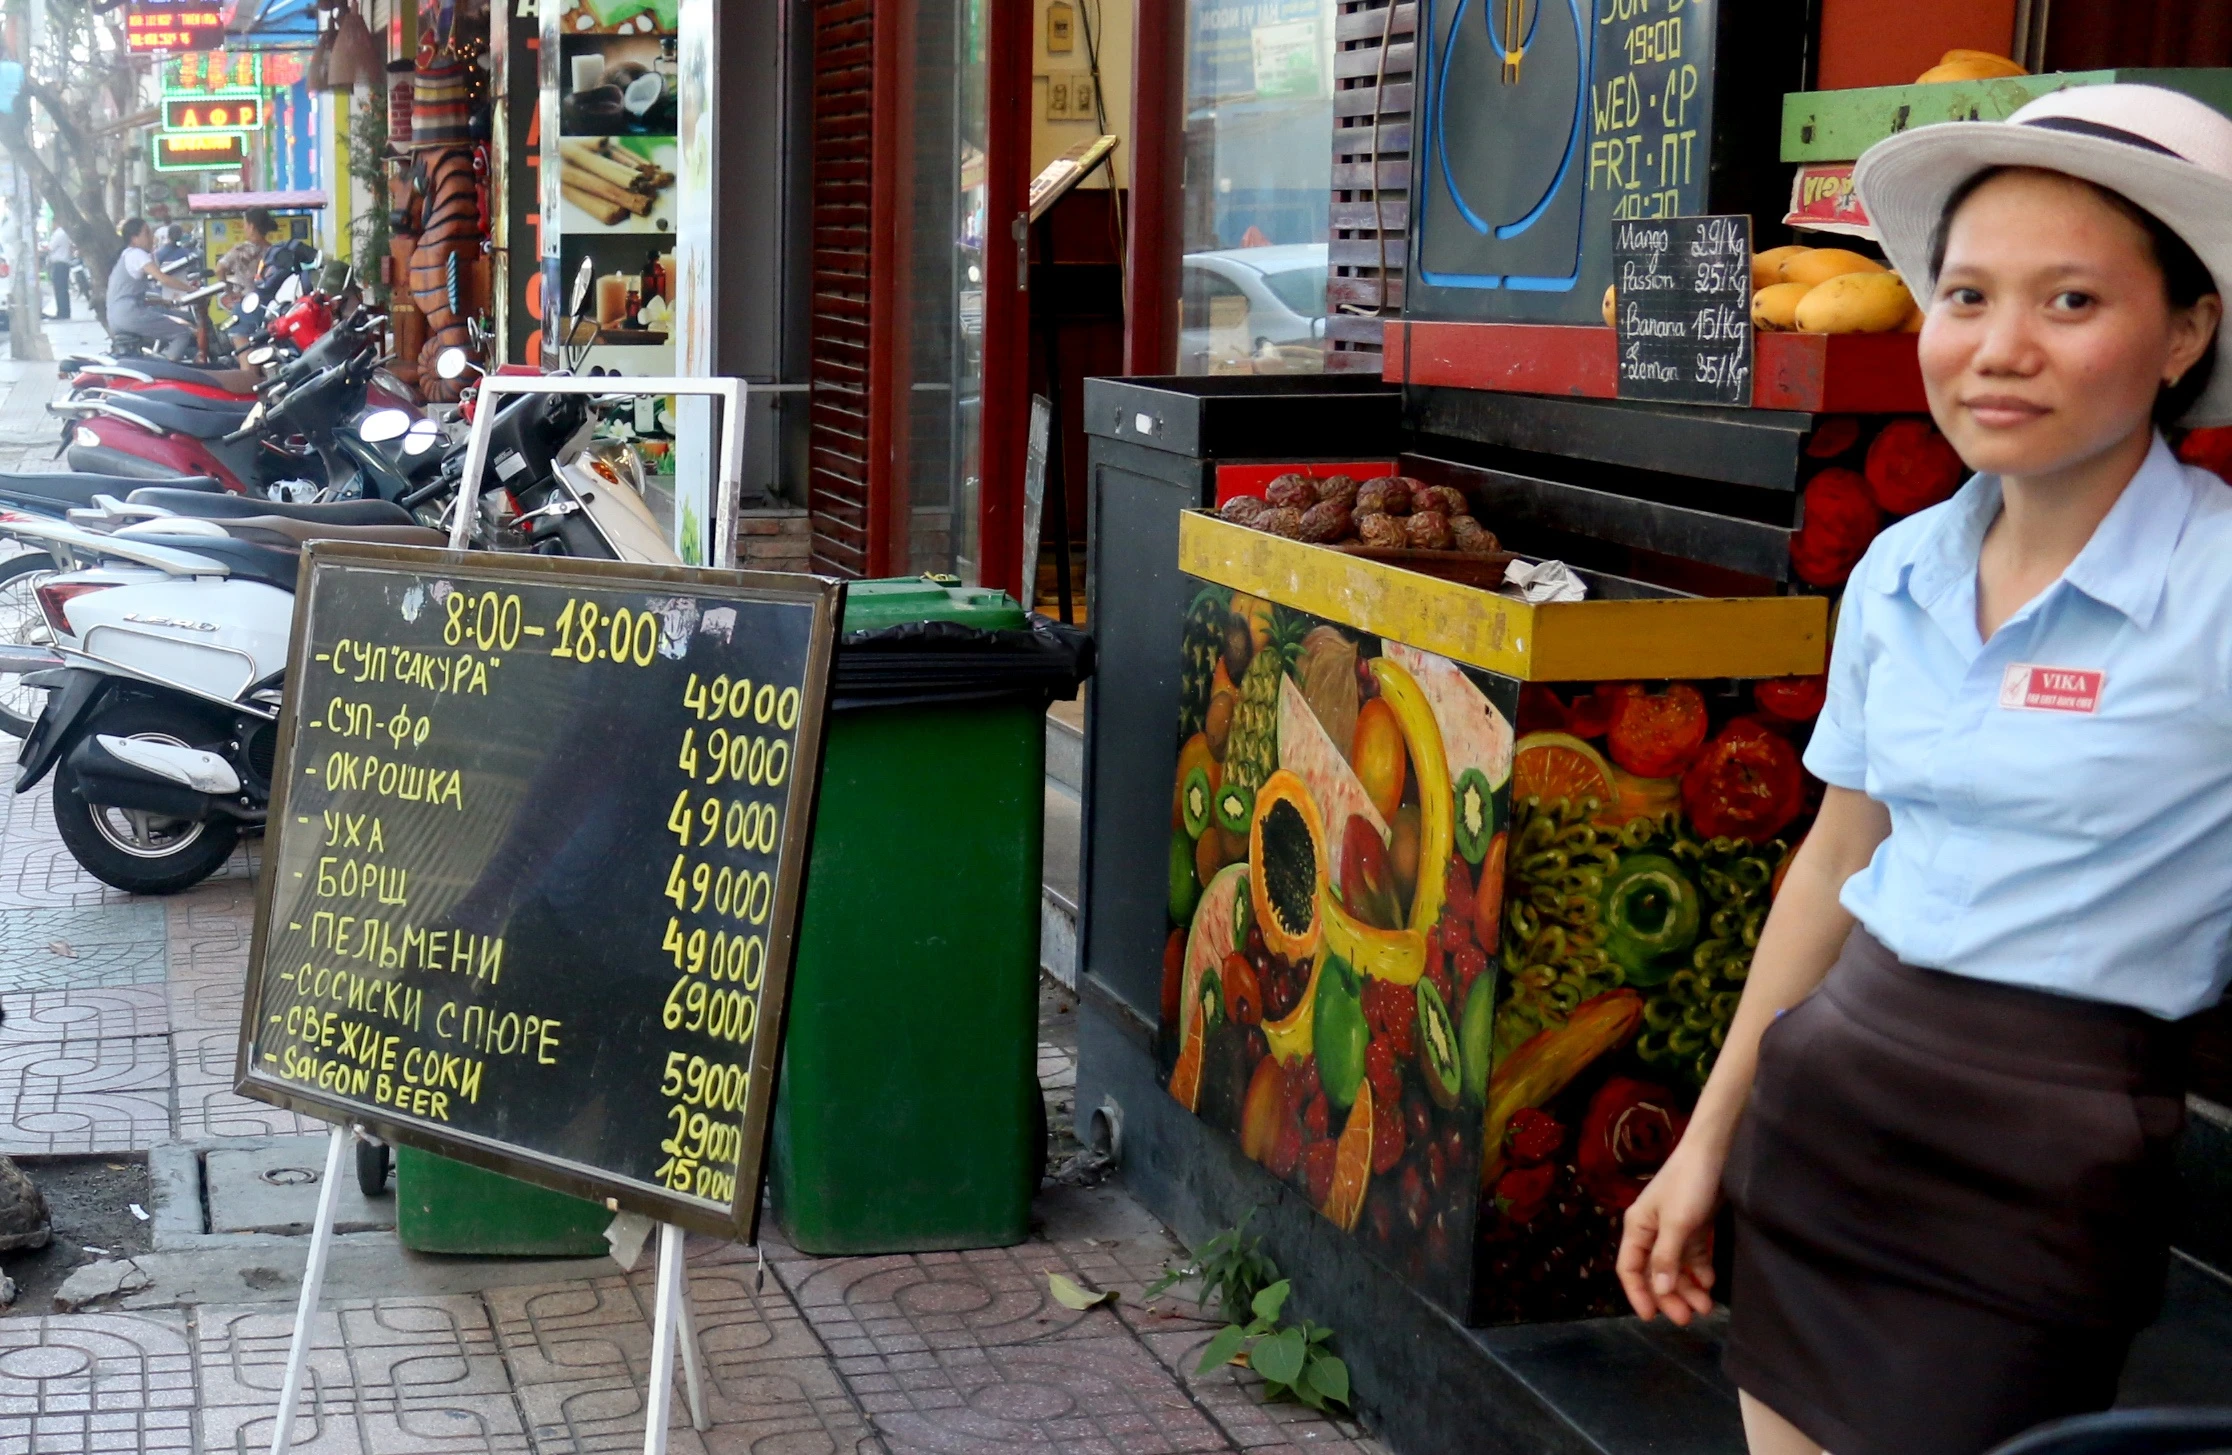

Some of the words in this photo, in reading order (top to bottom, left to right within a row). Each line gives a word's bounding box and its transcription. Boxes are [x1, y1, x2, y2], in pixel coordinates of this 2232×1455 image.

[1624, 16, 1681, 65] 19:00
[1593, 71, 1640, 135] WED
[1590, 135, 1642, 191] FRI
[1616, 223, 1669, 275] Mango
[1691, 218, 1745, 274] 29/Kg
[1623, 261, 1676, 294] Passion
[1695, 261, 1747, 309] 25/Kg
[1627, 302, 1686, 339] Banana
[1691, 304, 1746, 359] 15/Kg
[1626, 341, 1680, 383] Lemon
[684, 673, 799, 731] 49000
[2043, 672, 2087, 692] VIKA
[679, 727, 790, 787] 49000
[667, 789, 777, 854] 49000
[664, 854, 770, 925] 49000
[662, 916, 764, 991] 49000
[662, 975, 756, 1044] 69000
[376, 1074, 449, 1121] BEER
[403, 1047, 483, 1104] СОКИ
[661, 1104, 740, 1166] 29000
[661, 1051, 749, 1112] 59000
